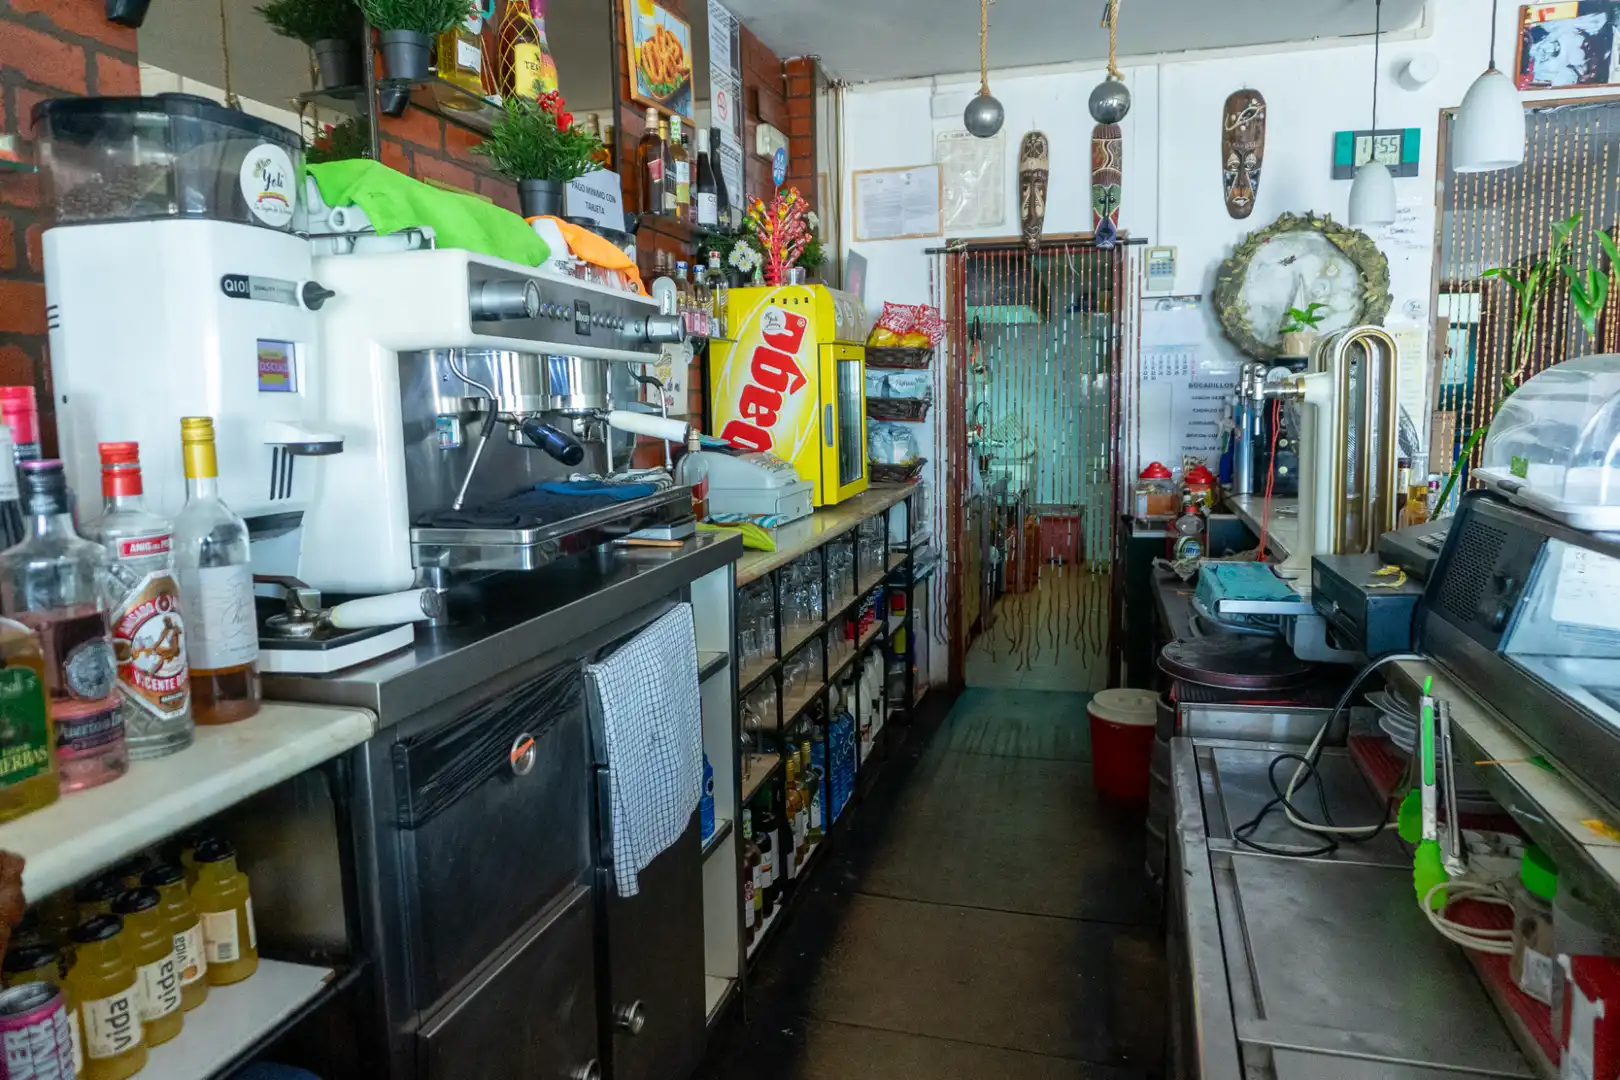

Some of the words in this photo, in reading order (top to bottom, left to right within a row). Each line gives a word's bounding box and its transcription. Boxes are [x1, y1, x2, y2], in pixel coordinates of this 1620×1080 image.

[174, 935, 188, 963] vida
[156, 960, 177, 1011] vida
[104, 997, 132, 1052] vida
